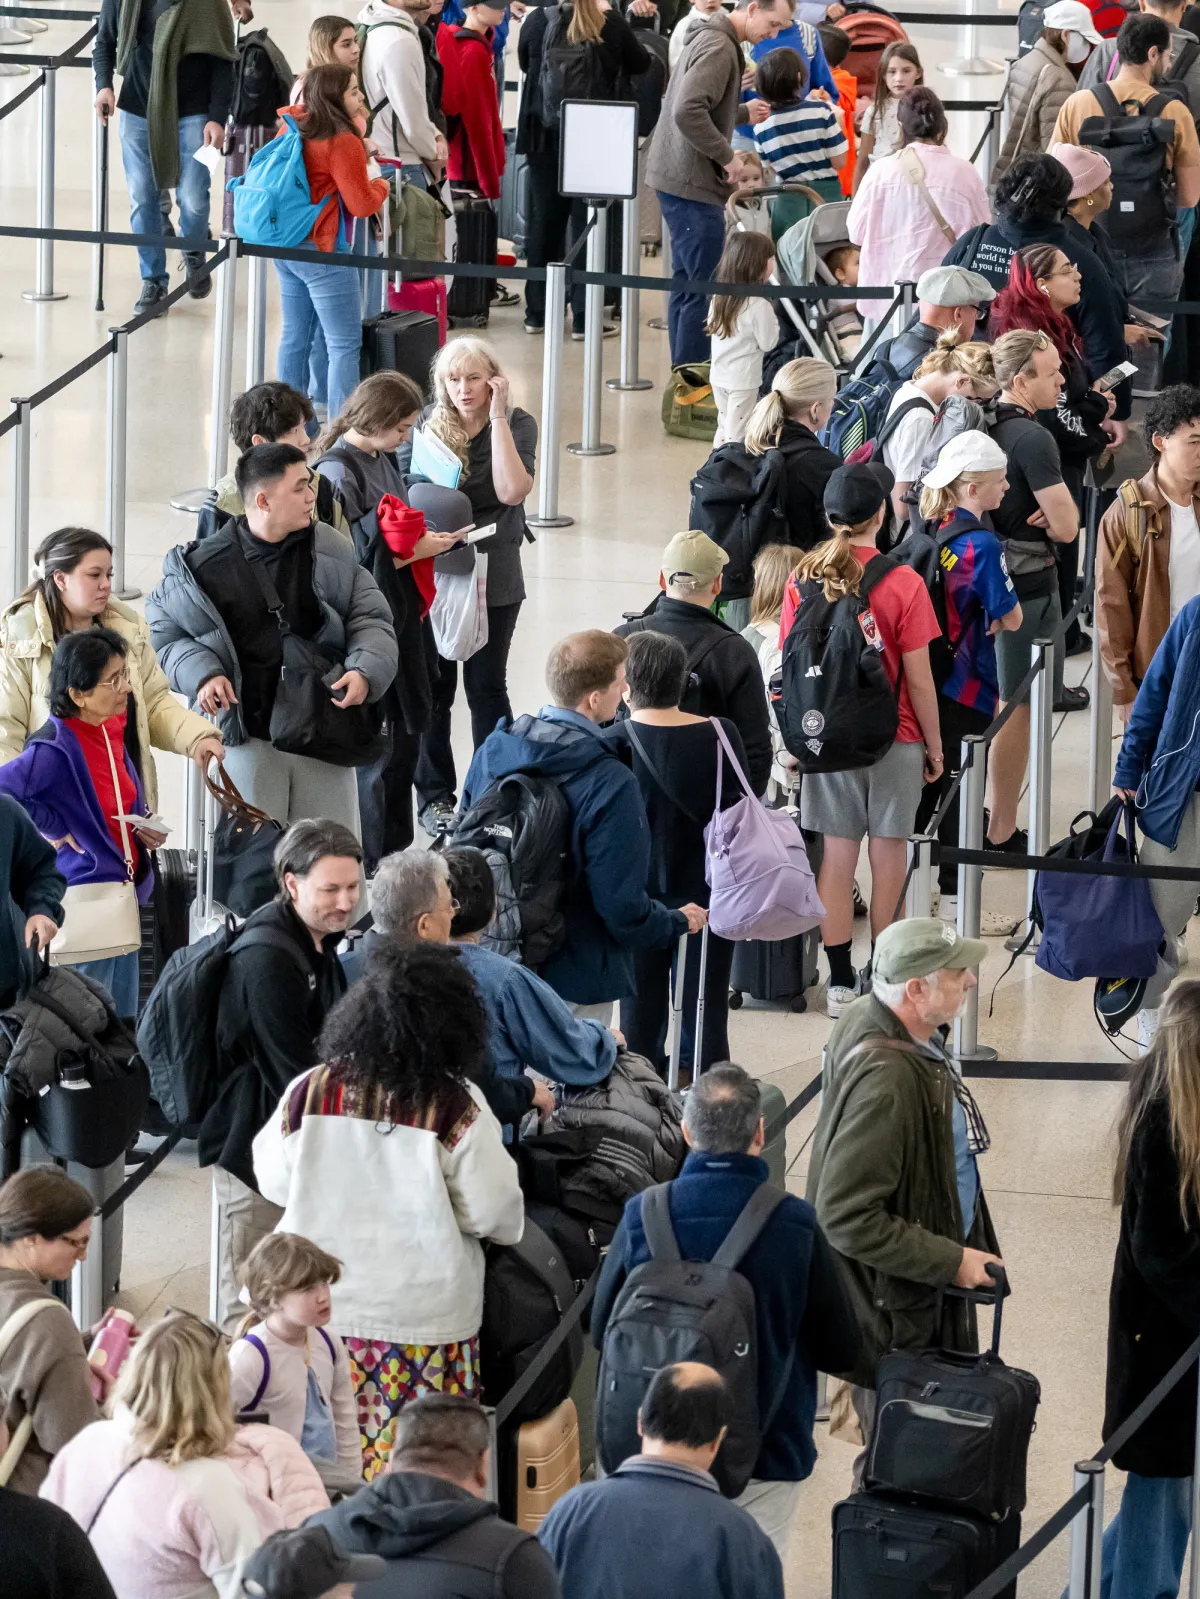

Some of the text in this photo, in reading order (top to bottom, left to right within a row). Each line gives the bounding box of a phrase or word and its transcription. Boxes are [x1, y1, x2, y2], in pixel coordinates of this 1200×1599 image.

[981, 243, 1007, 254] person
[976, 252, 997, 262] world
[998, 255, 1006, 264] is
[978, 263, 993, 272] you
[994, 264, 1003, 273] in
